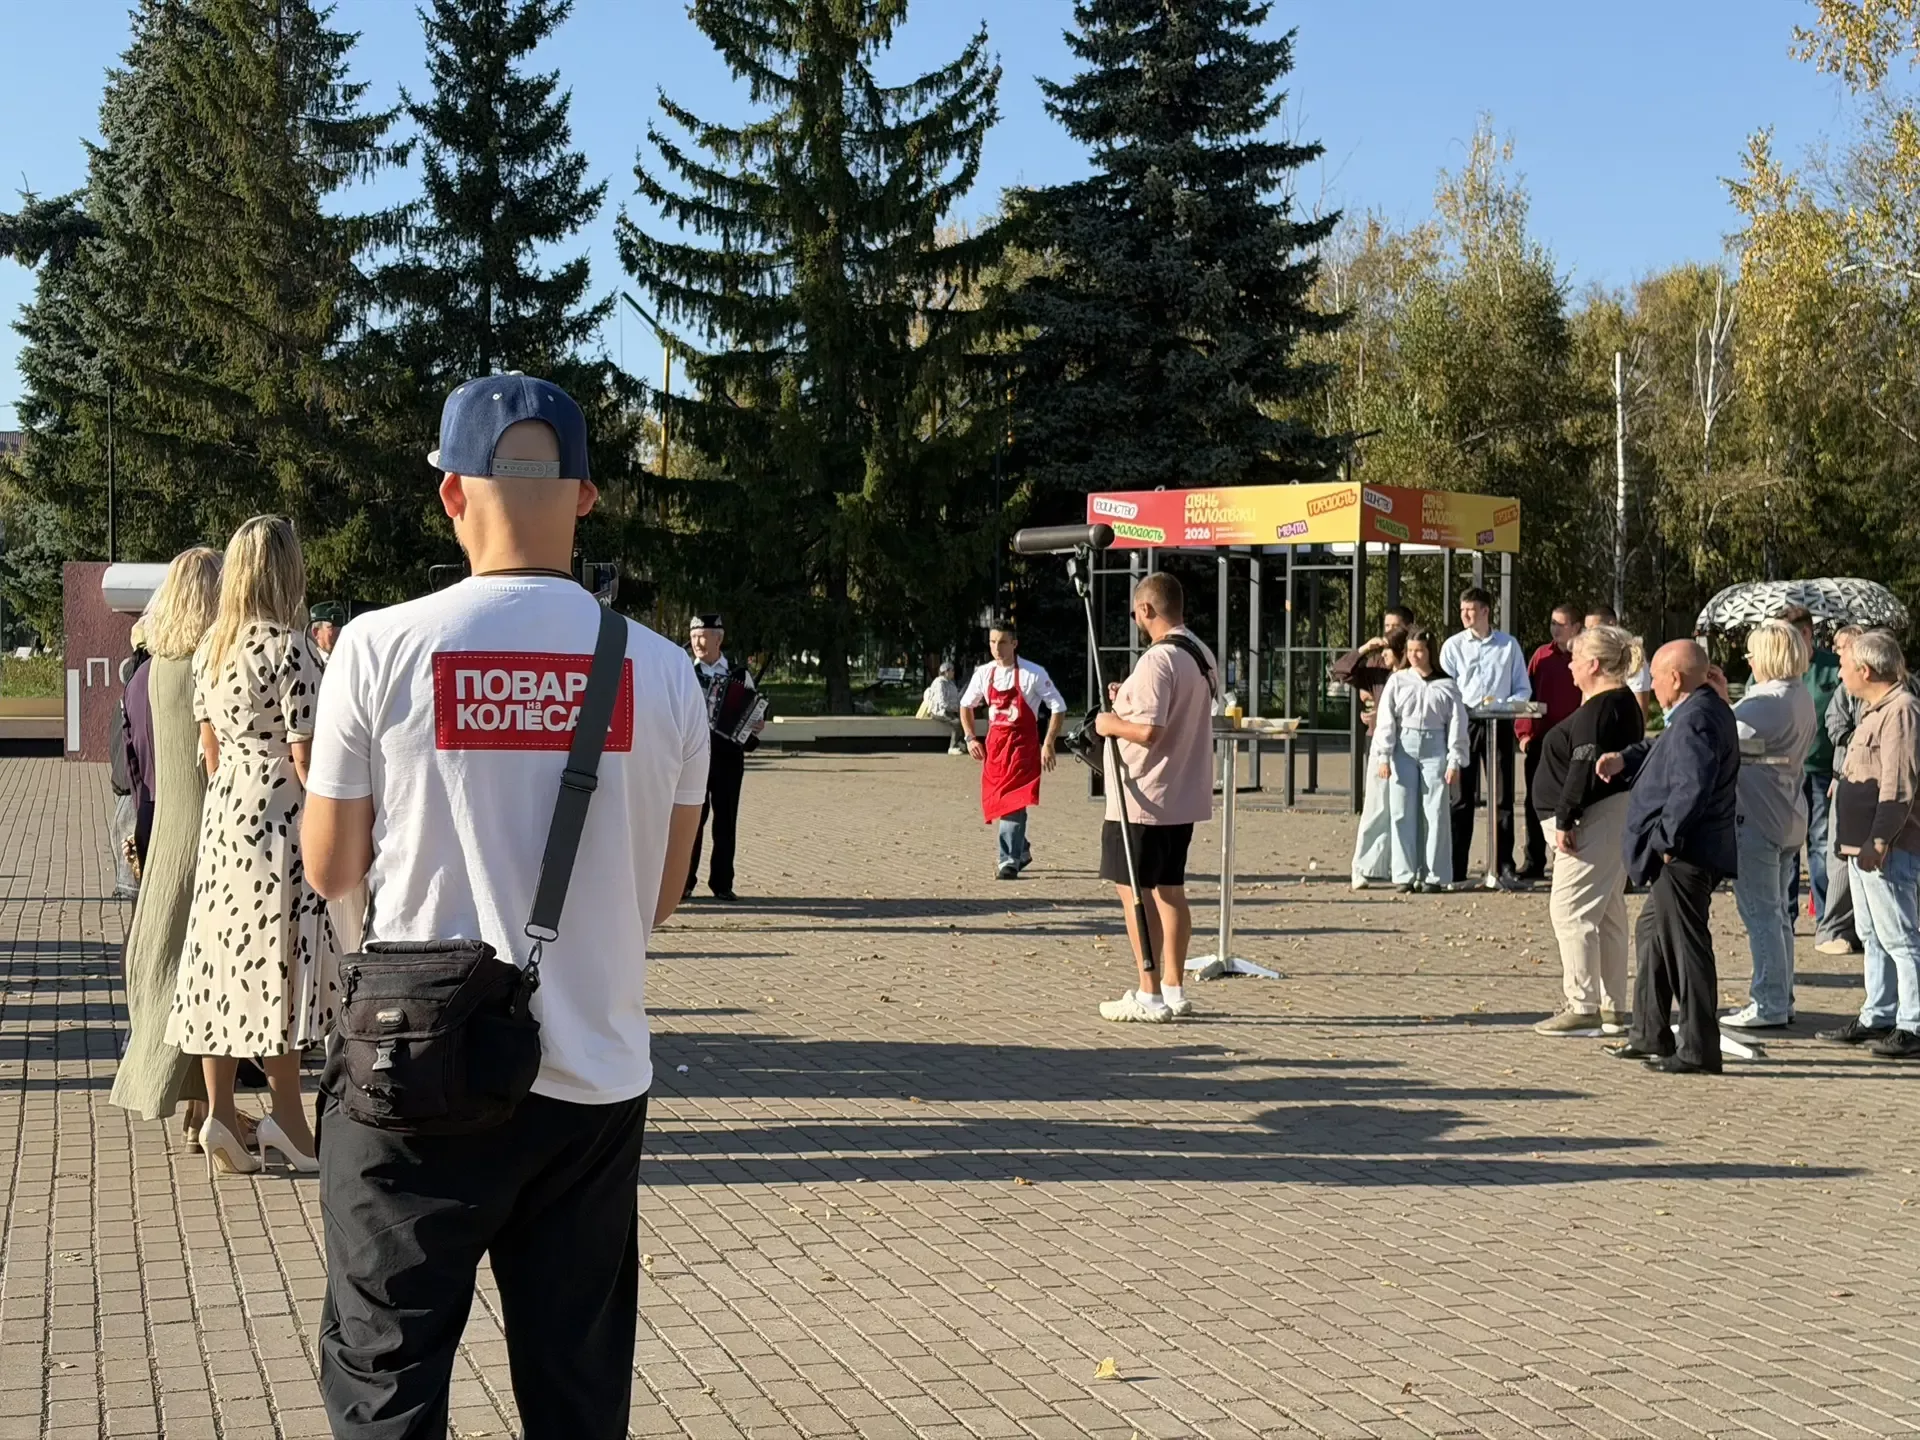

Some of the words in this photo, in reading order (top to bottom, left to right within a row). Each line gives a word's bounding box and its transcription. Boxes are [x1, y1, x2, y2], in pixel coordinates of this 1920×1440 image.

[1184, 527, 1211, 540] 2026
[455, 669, 588, 702] ПОВАР
[526, 701, 541, 710] на
